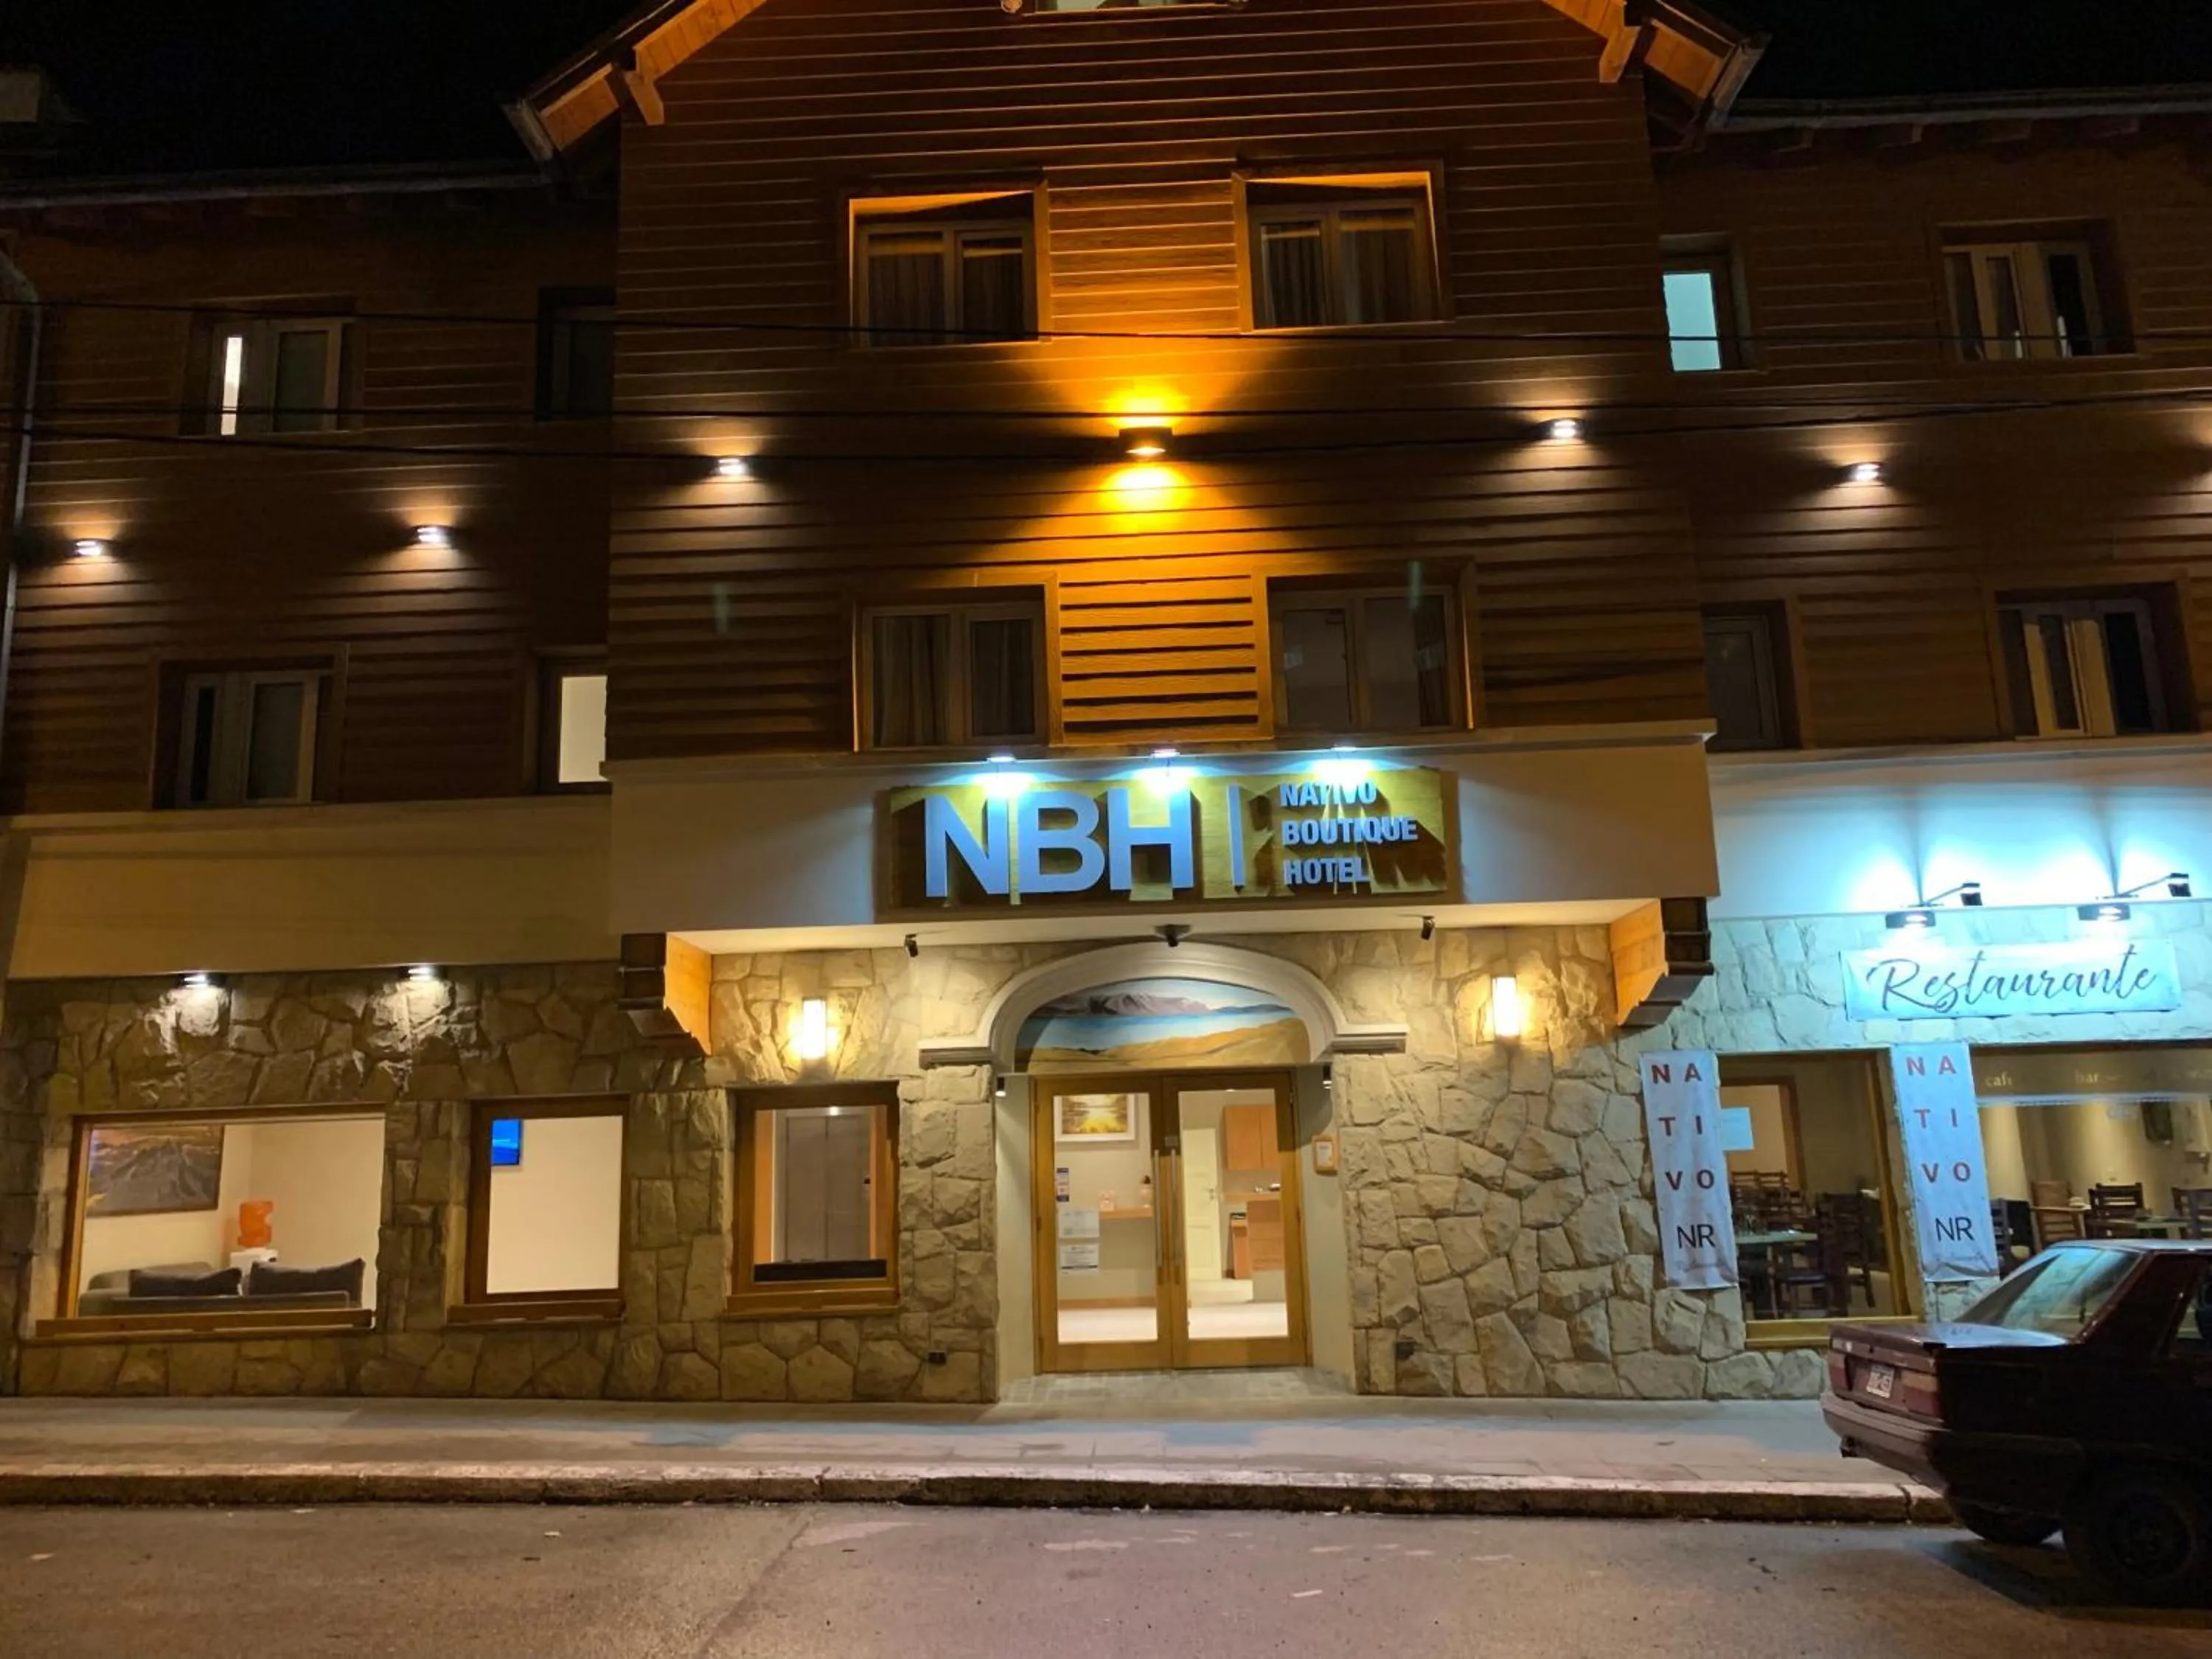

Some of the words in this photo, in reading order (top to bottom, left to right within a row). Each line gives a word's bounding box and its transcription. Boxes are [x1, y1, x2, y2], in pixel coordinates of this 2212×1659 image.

[1279, 781, 1377, 807] NATIVO
[925, 787, 1194, 897] NBH
[1281, 816, 1419, 845] BOUTIQUE
[1283, 857, 1370, 885] HOTEL
[1866, 944, 2157, 1013] Restaurante
[1676, 1223, 1716, 1249] NR
[1935, 1217, 1975, 1242] NR
